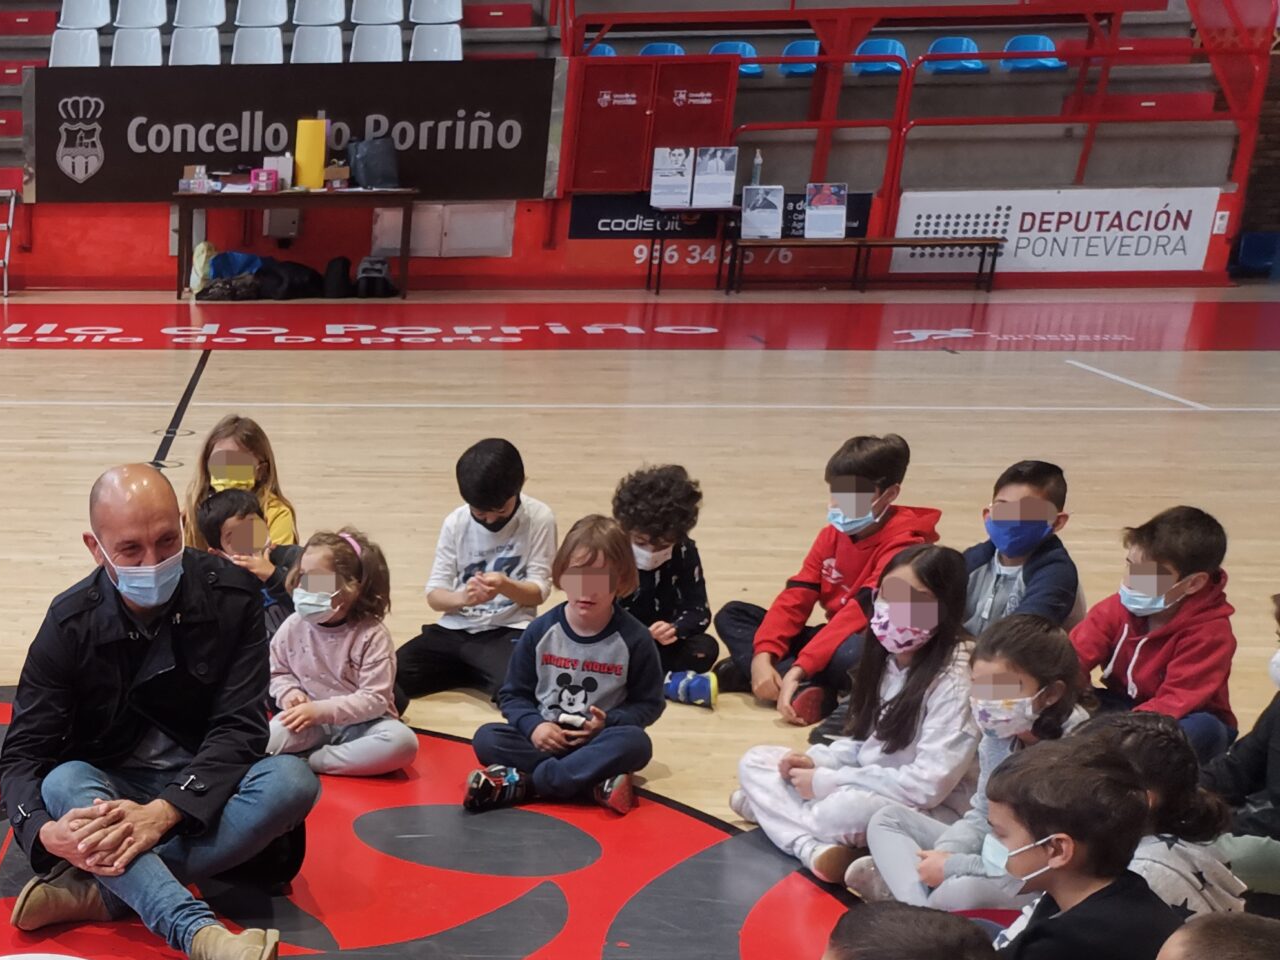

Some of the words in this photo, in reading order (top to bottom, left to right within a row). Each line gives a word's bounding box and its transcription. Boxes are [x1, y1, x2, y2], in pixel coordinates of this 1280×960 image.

[127, 110, 289, 153] Concello
[365, 109, 522, 151] Porriño
[1018, 203, 1193, 233] DEPUTACIÓN
[686, 245, 717, 264] 34
[1014, 235, 1187, 258] PONTEVEDRA
[160, 323, 289, 335] do
[325, 322, 719, 336] Porriño
[274, 335, 523, 345] Deporte
